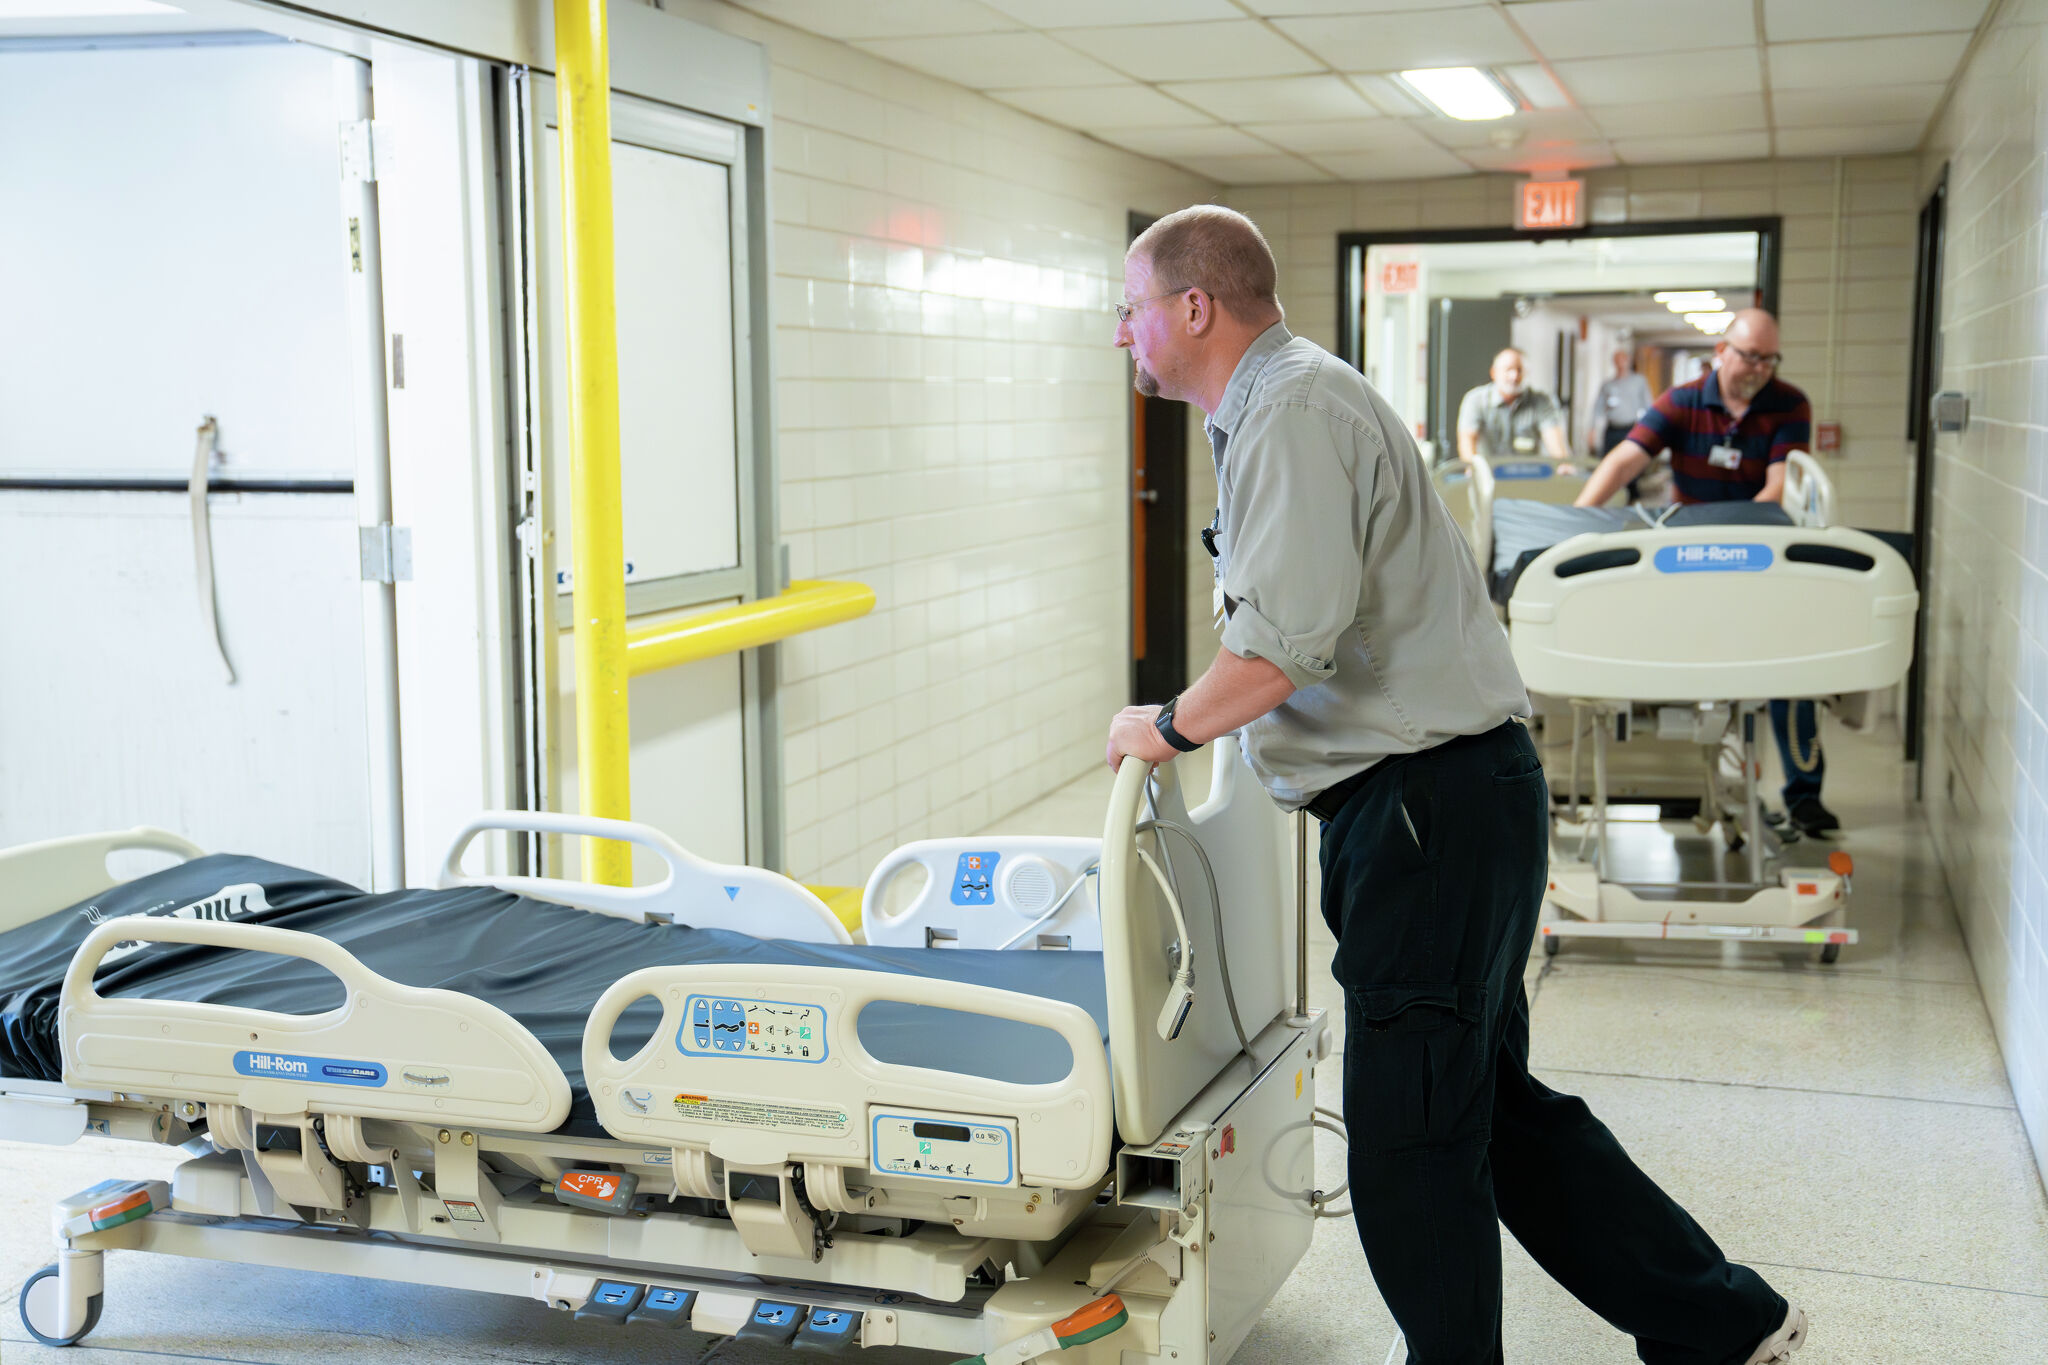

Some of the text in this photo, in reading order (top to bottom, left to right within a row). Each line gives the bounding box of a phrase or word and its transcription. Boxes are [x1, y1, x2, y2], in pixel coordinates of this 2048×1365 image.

[1523, 181, 1579, 227] EXIT
[1677, 545, 1749, 562] Hill-Rom
[249, 1053, 308, 1074] Hill-Rom
[578, 1174, 604, 1185] CPR
